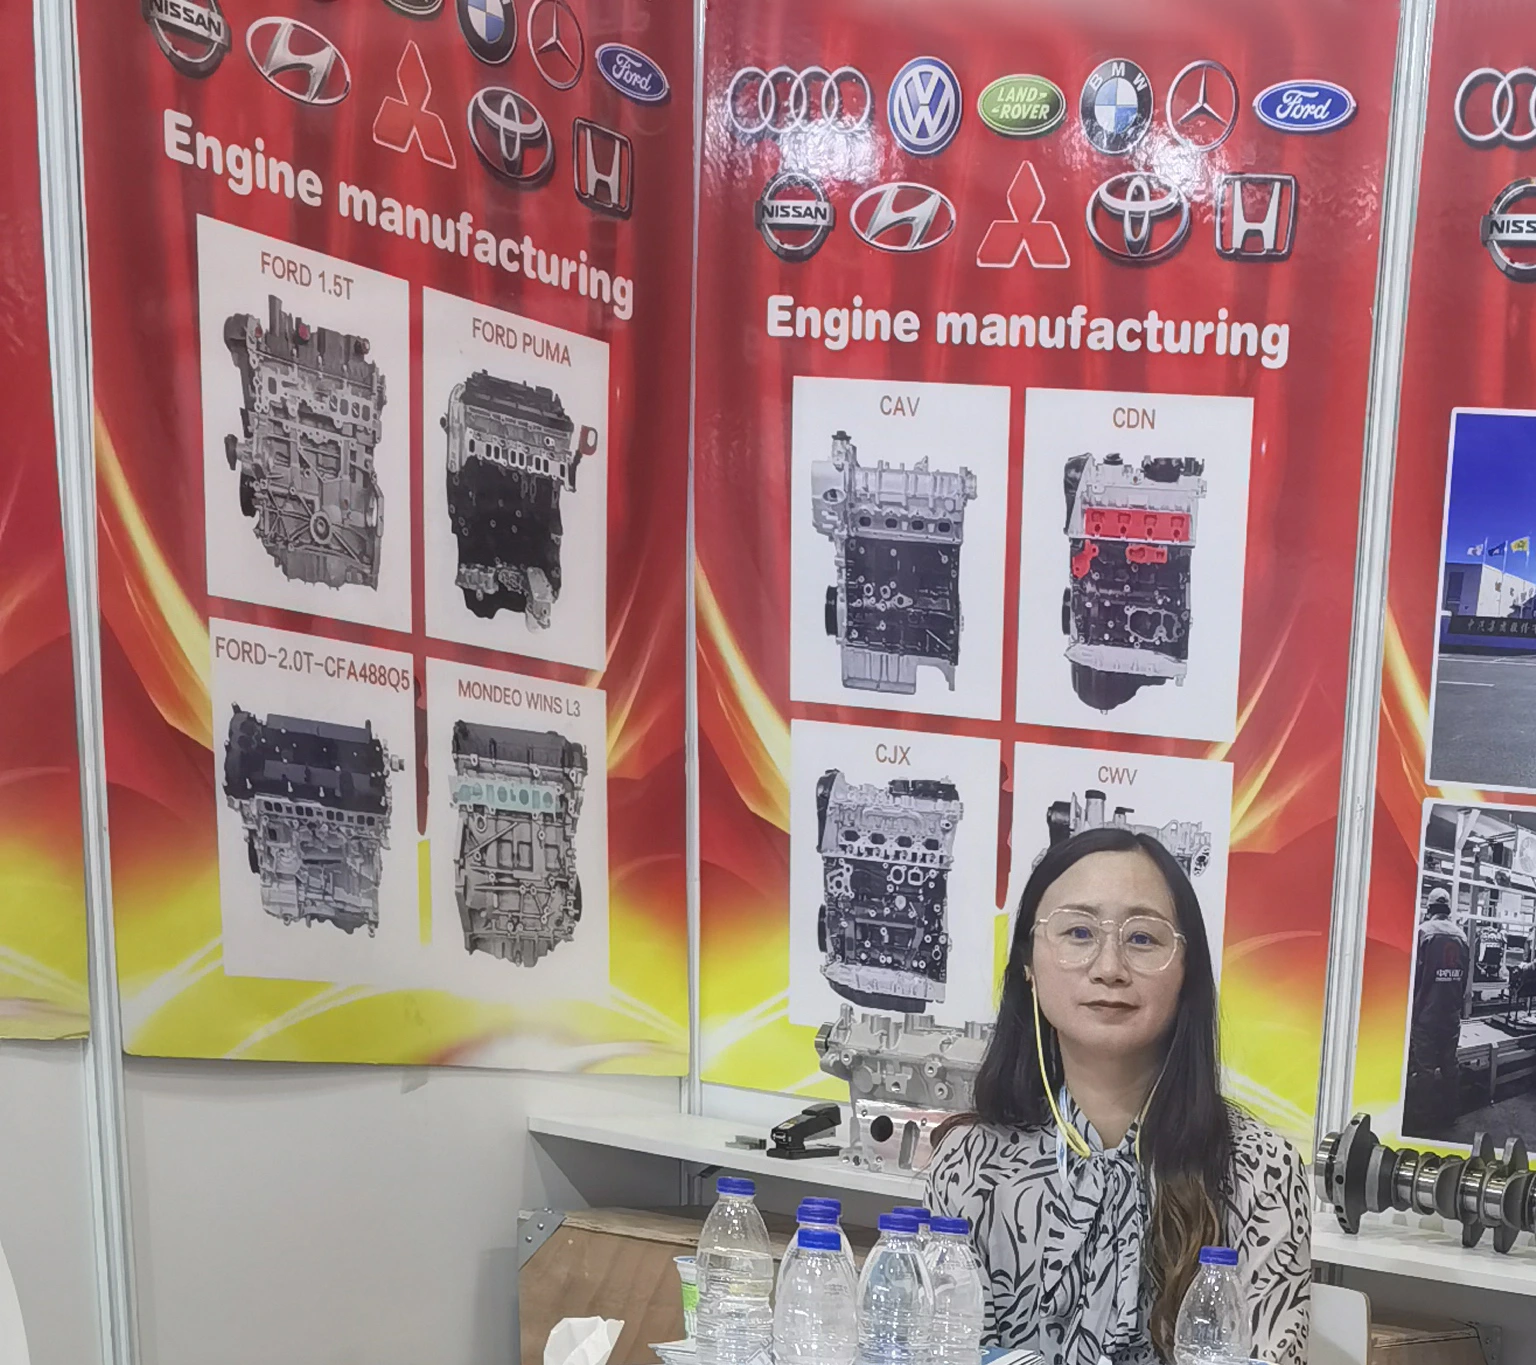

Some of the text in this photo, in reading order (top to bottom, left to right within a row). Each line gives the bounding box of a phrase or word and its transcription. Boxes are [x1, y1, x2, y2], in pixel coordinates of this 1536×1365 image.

[612, 52, 653, 92] Ford
[1279, 91, 1331, 120] Ford
[164, 109, 634, 320] Engine manufacturing
[761, 203, 828, 222] NISSAN
[261, 250, 354, 300] FORD 1.5T
[472, 318, 572, 367] FORD PUMA
[767, 294, 1290, 370] Engine manufacturing
[880, 395, 920, 418] CAV
[1112, 407, 1156, 431] CDN
[458, 679, 581, 718] MONDEO WINS L3
[875, 743, 911, 767] CJX
[1098, 766, 1138, 787] CWV
